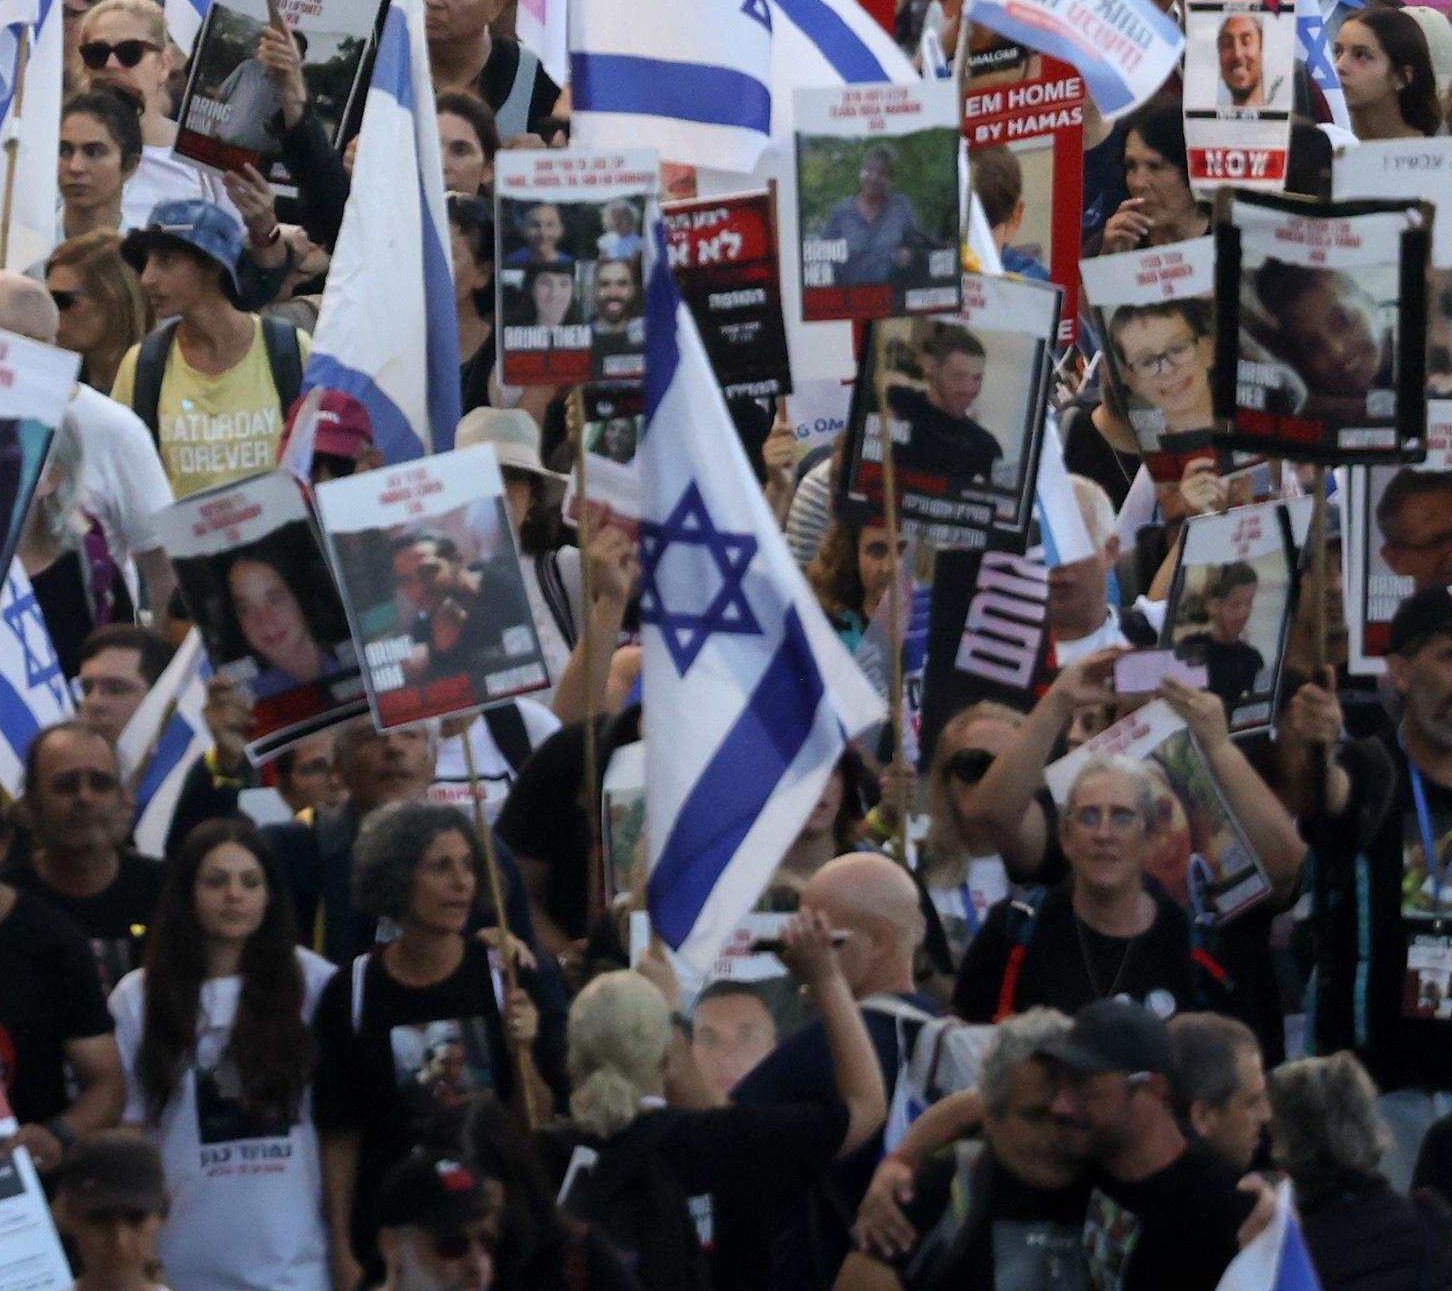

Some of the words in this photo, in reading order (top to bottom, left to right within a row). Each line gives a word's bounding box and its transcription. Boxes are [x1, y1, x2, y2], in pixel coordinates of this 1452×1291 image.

[1009, 78, 1081, 111] HOME
[974, 120, 1004, 143] BY
[1007, 107, 1082, 139] HAMAS
[1205, 148, 1268, 176] NOW
[697, 228, 742, 262] לא
[504, 325, 550, 351] BRING
[554, 326, 592, 351] THEM
[159, 406, 276, 441] SATURDAY
[167, 439, 272, 475] FOREVER
[365, 636, 411, 668] BRING
[372, 665, 405, 691] HIM
